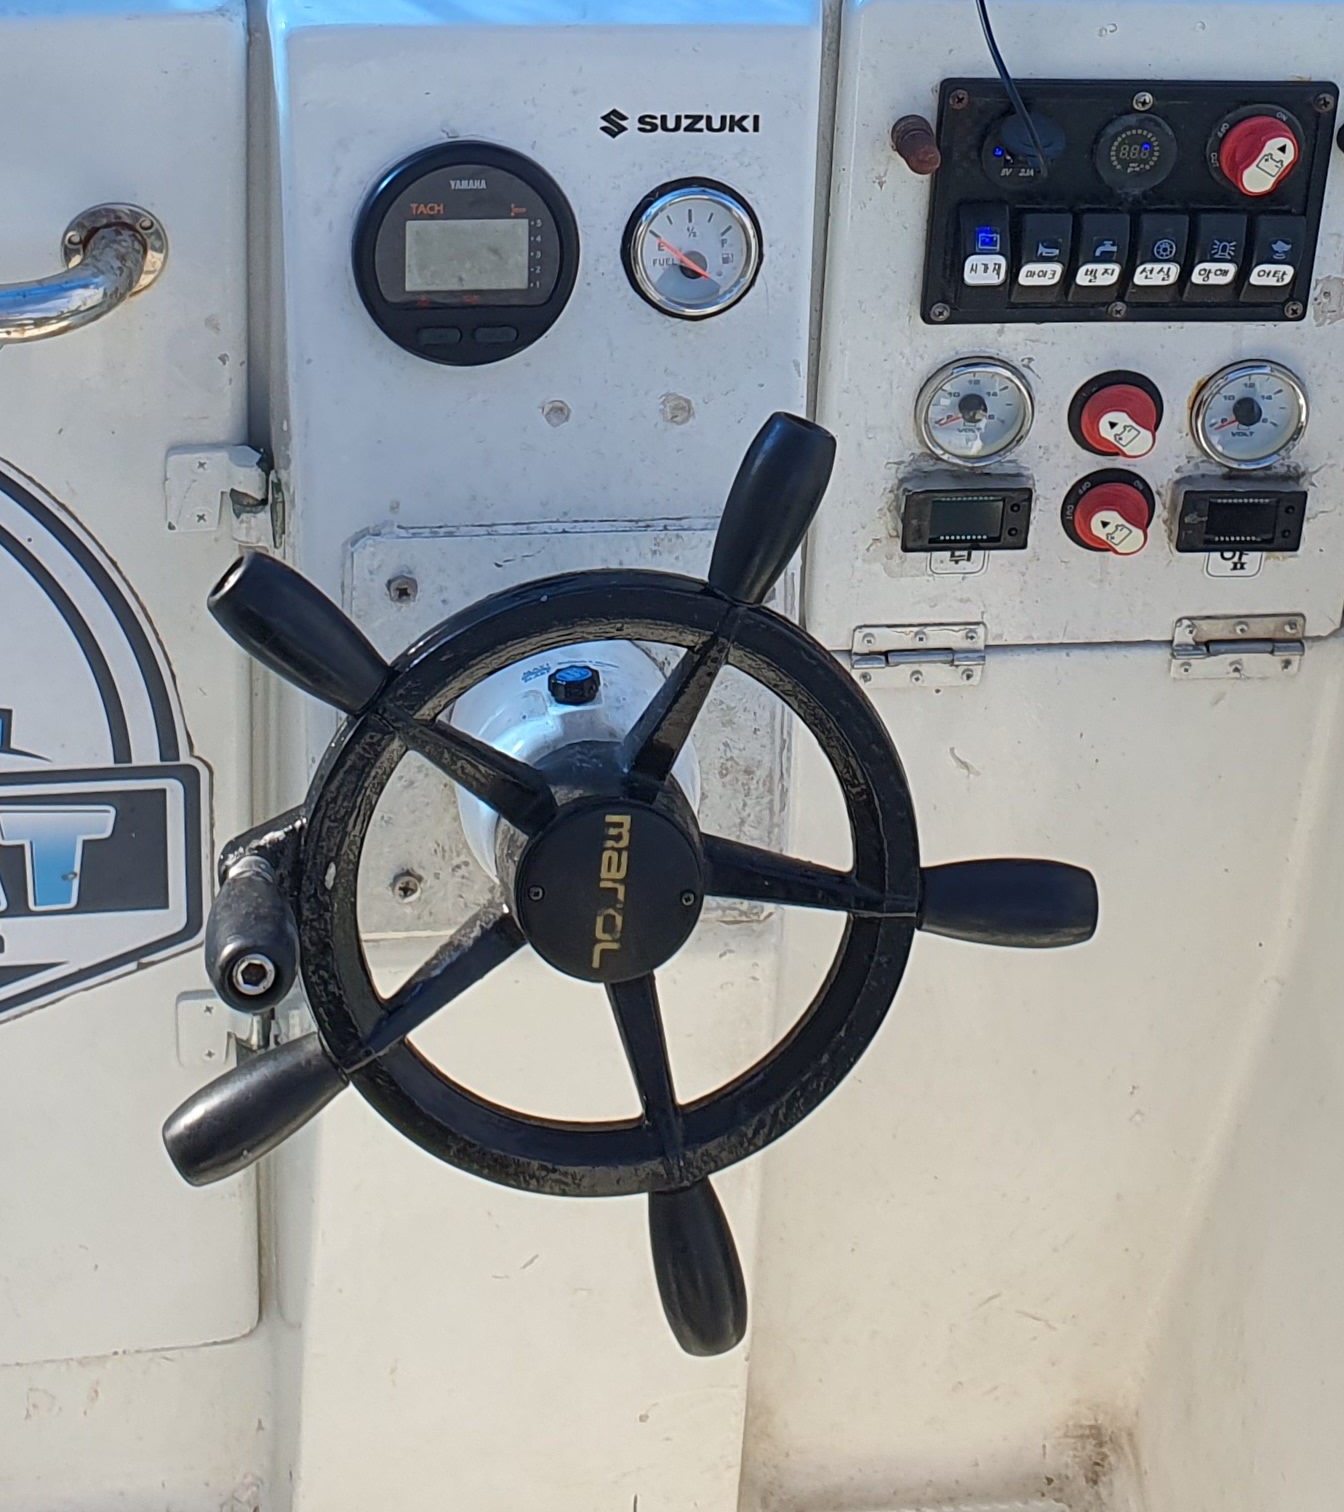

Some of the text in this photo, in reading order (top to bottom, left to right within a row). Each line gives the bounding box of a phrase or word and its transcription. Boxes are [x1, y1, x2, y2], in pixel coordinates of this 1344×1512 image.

[637, 114, 760, 133] SUZUKI
[450, 179, 487, 190] YAMAHA
[410, 203, 444, 214] TACH
[721, 239, 728, 248] F
[652, 257, 677, 267] FUEL
[1025, 269, 1057, 280] 마이크
[1084, 267, 1115, 283] 빌지
[1139, 267, 1171, 282] 선실
[1198, 268, 1230, 282] 항해
[1257, 269, 1288, 283] 어탐
